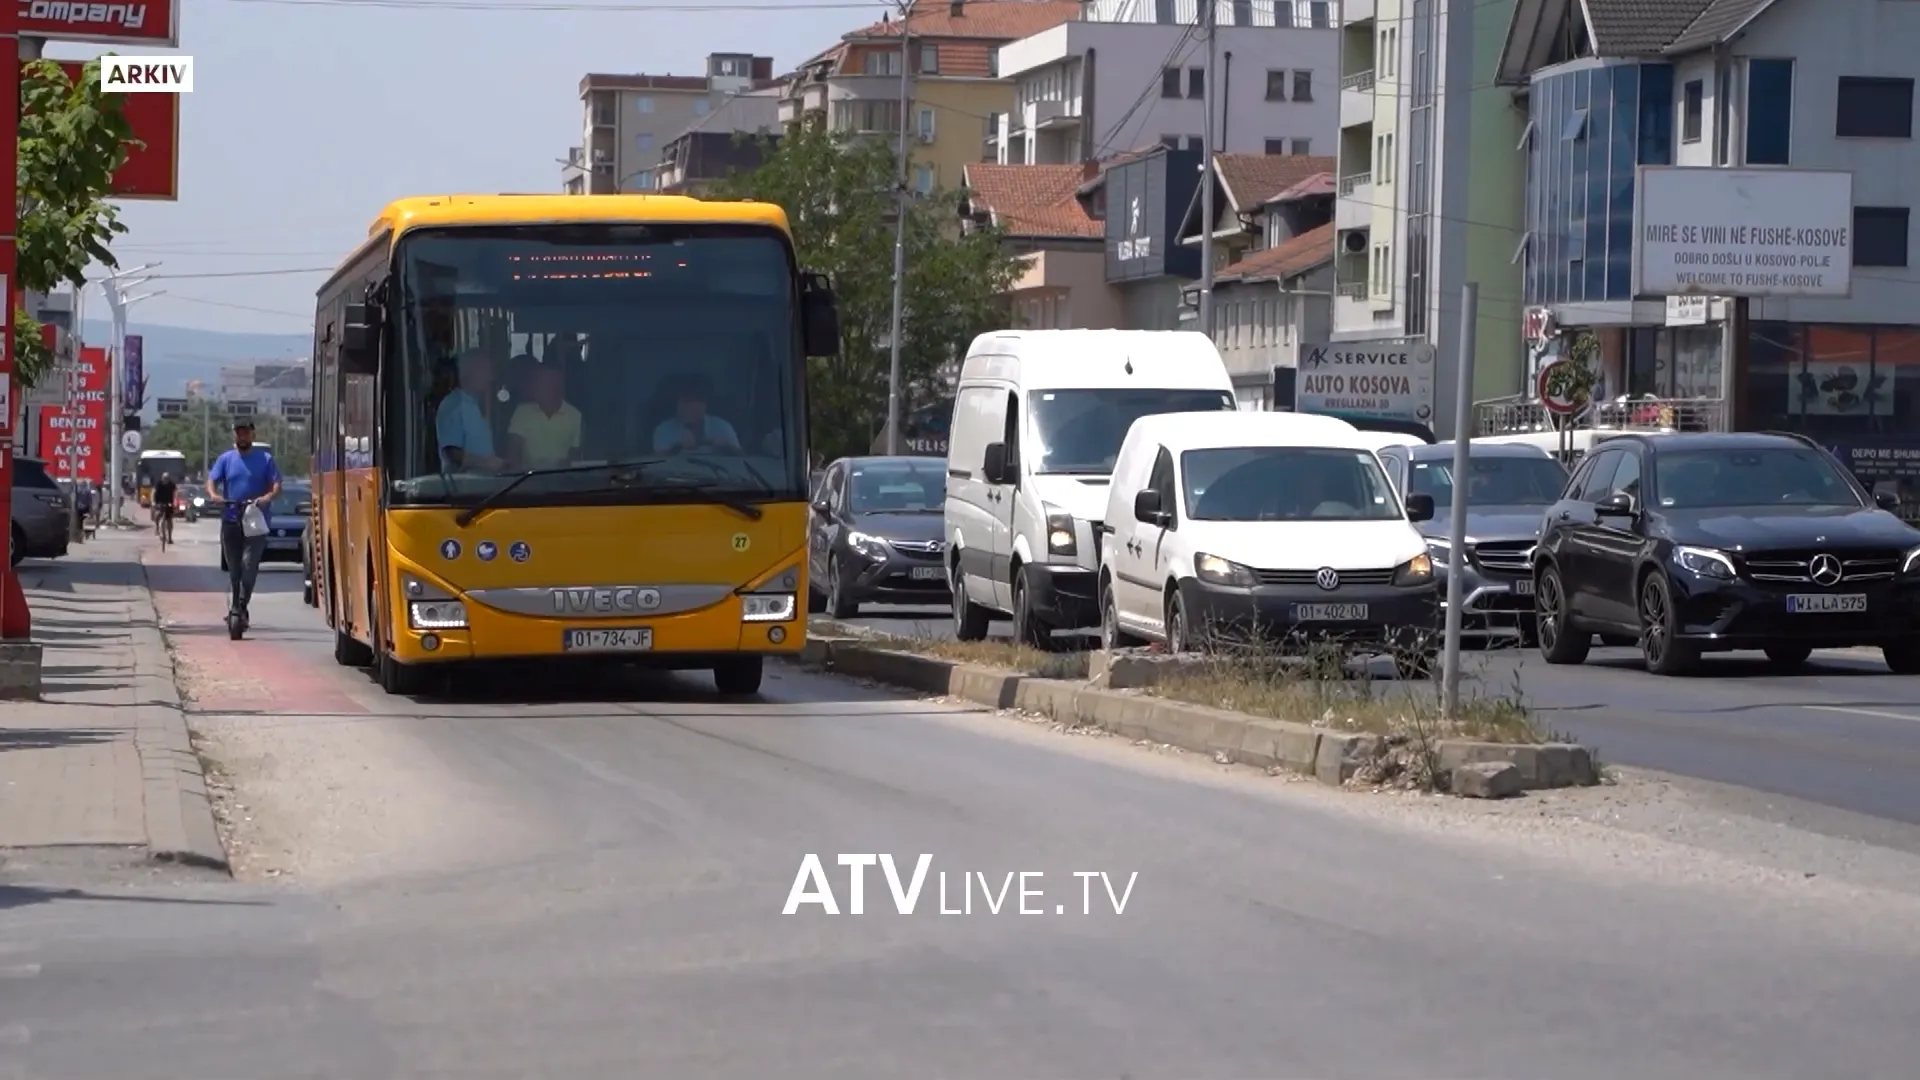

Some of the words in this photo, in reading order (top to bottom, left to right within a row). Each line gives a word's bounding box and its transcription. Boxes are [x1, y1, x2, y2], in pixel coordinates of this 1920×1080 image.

[1682, 226, 1697, 244] SE
[1701, 227, 1726, 244] VINI
[1674, 253, 1709, 265] DOBRO
[1745, 254, 1752, 265] U
[1676, 273, 1727, 285] WELCOME
[1730, 273, 1743, 286] TO
[1334, 352, 1408, 365] SERVICE
[1304, 375, 1344, 394] AUTO
[1350, 376, 1410, 395] KOSOVA
[734, 537, 747, 549] 27
[553, 589, 662, 612] IVECO
